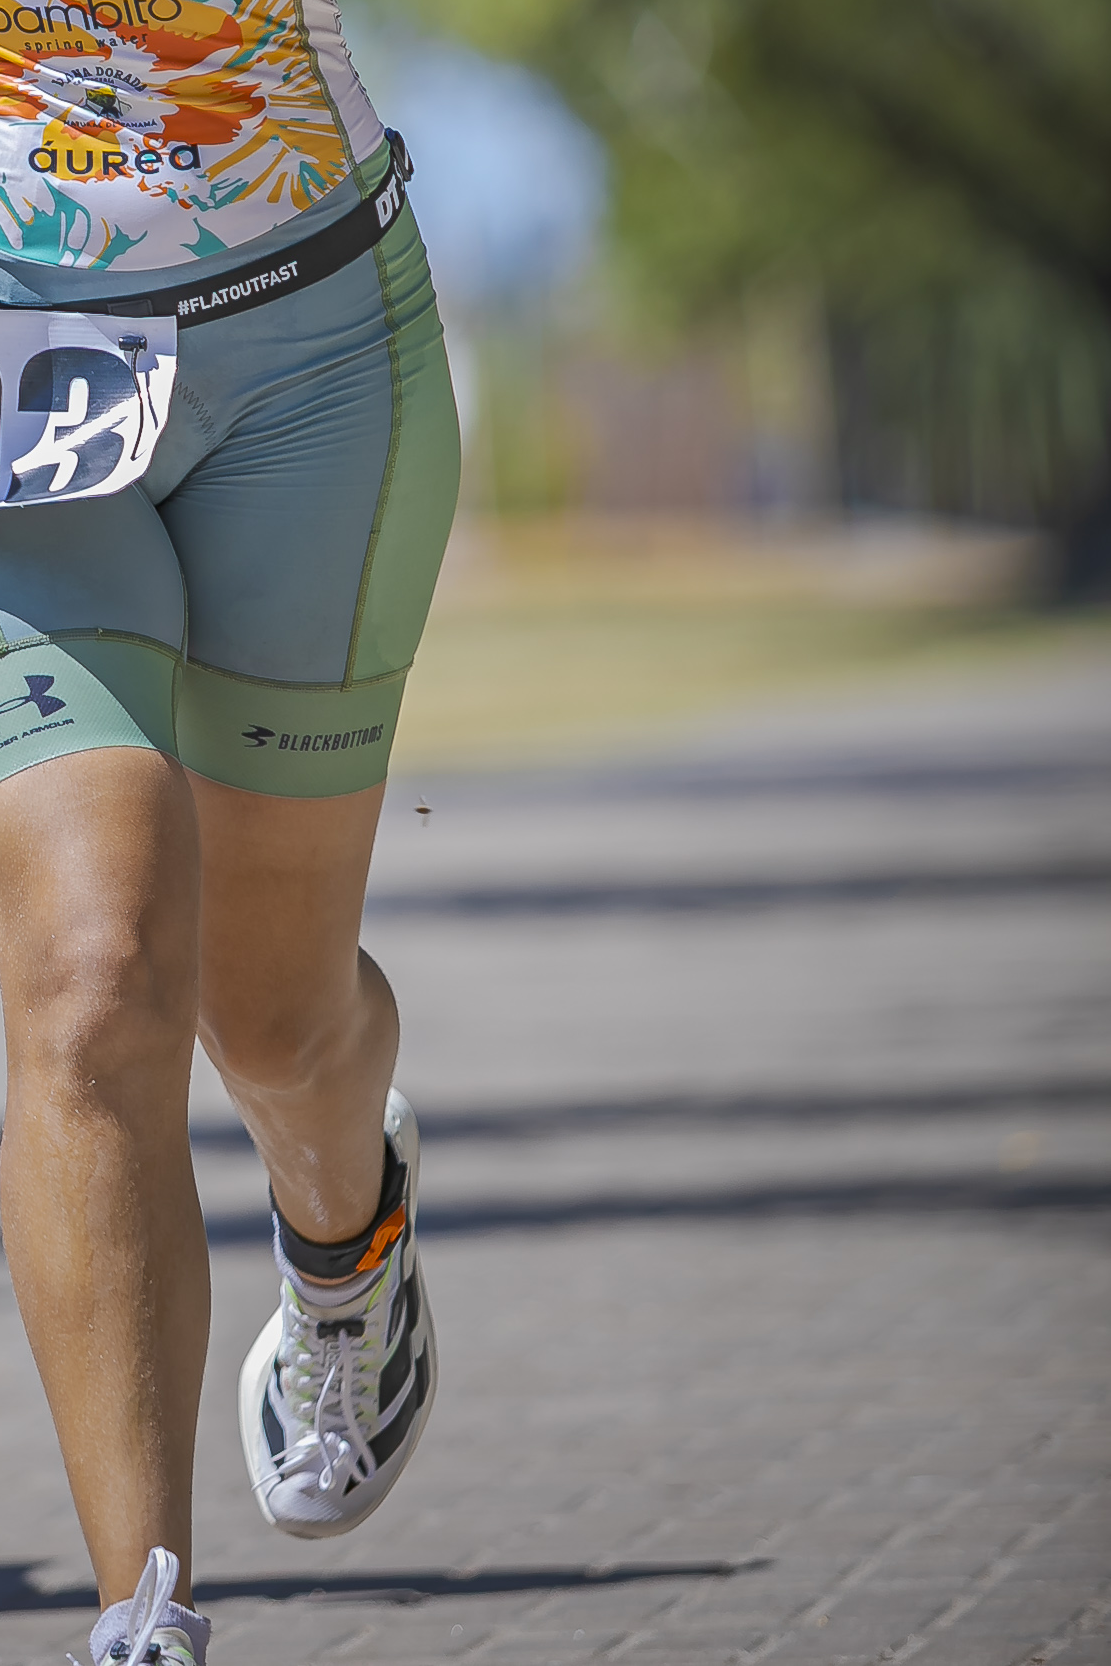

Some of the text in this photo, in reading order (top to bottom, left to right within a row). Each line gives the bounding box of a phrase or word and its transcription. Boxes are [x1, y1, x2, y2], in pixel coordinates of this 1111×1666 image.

[24, 33, 149, 54] spring water
[95, 66, 148, 92] DORADA
[178, 261, 298, 315] #FLATOUTFAST
[22, 719, 74, 738] ARMOUR
